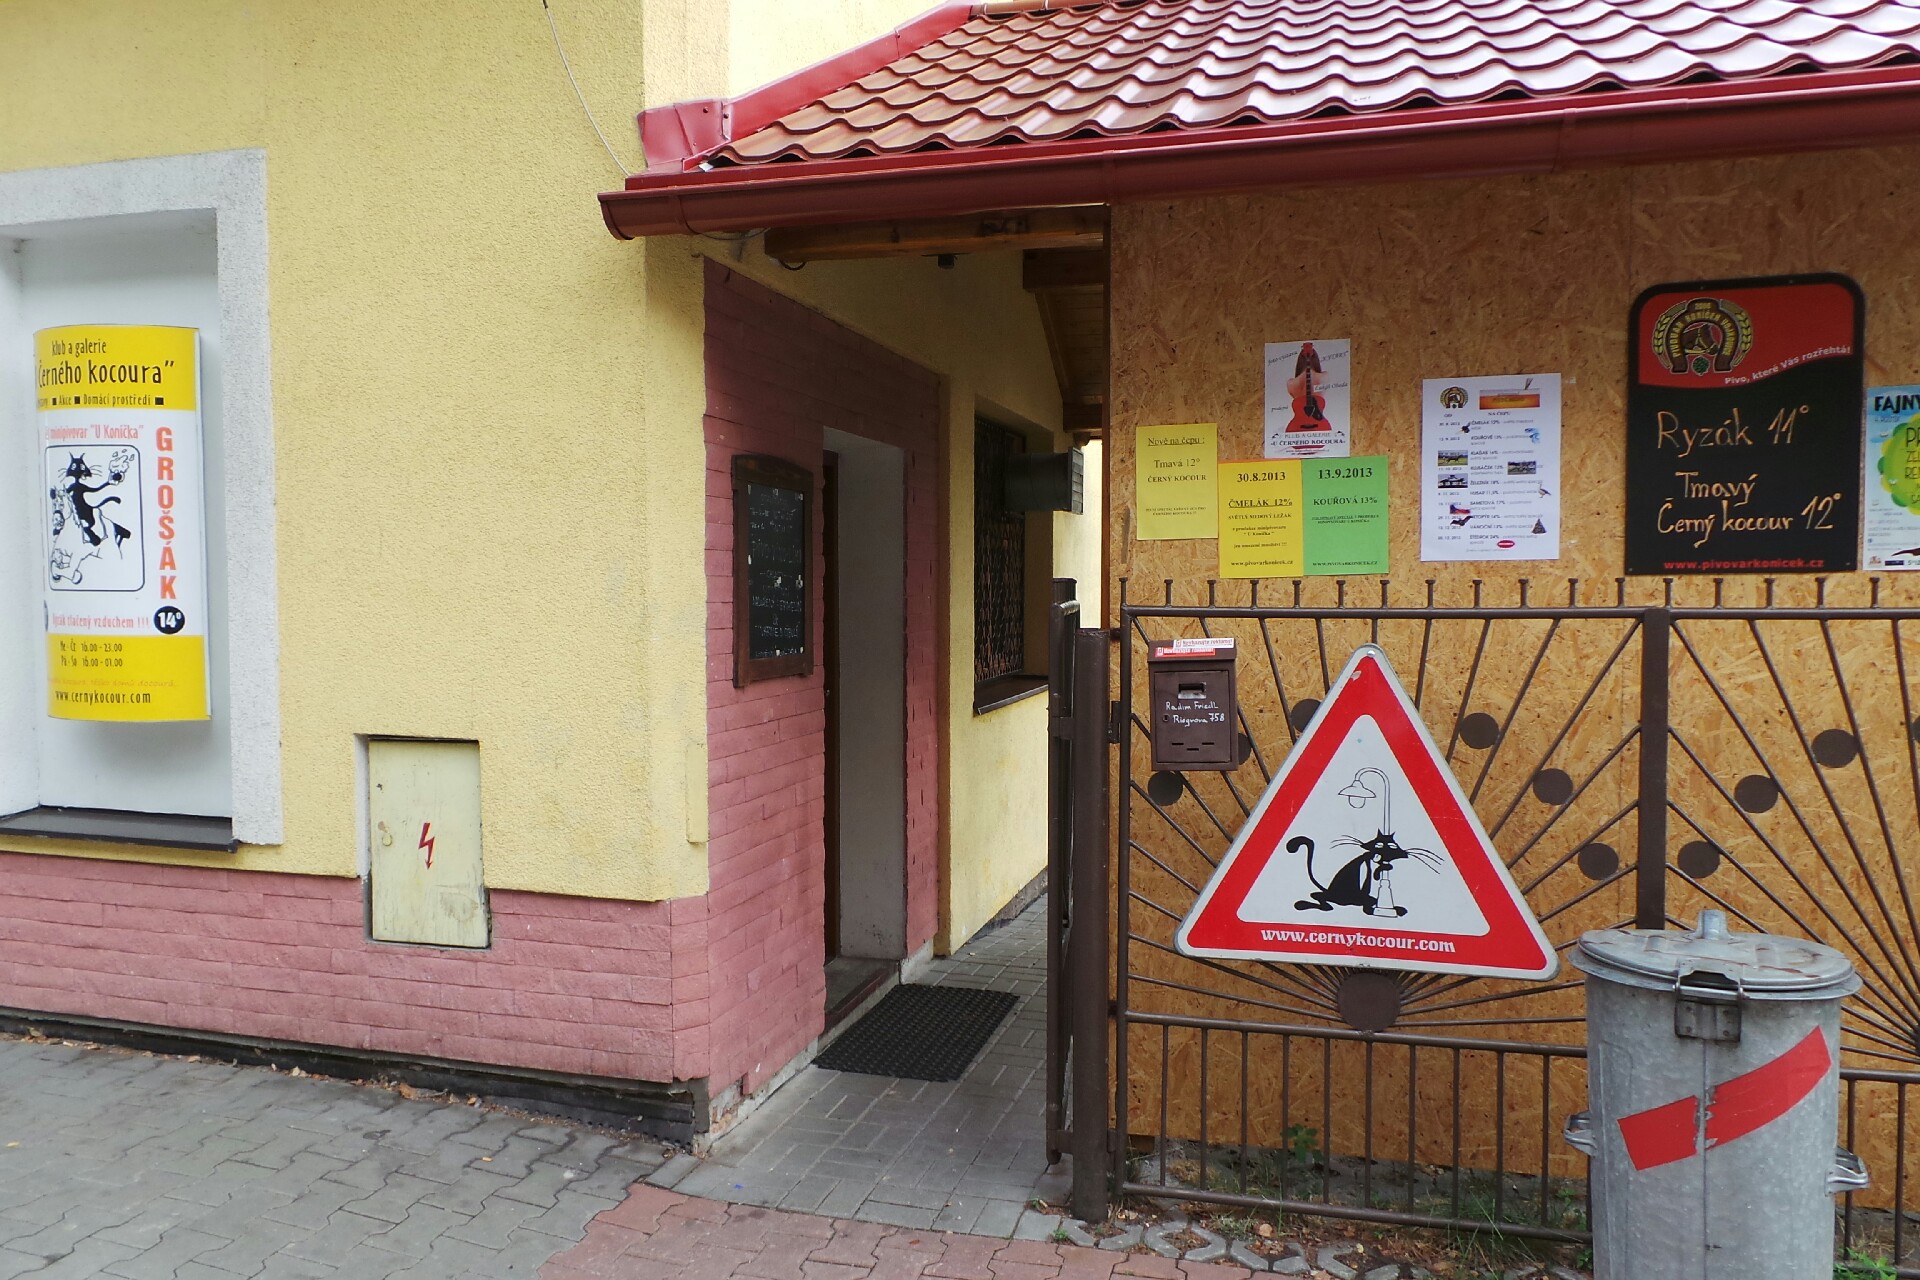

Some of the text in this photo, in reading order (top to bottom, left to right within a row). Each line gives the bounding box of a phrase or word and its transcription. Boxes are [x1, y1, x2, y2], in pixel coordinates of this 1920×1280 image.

[52, 339, 107, 358] klub a galerie
[1725, 345, 1851, 385] Pivo, které Vás rozřehtá!
[1657, 407, 1753, 458] Ryzák
[1181, 437, 1200, 447] čepu
[1154, 459, 1183, 468] Tmavá
[1147, 474, 1207, 483] ČERNÝ KOCOUR
[1237, 471, 1286, 483] 30.8.2013
[1318, 467, 1373, 479] 13.9.2013
[1675, 471, 1758, 507] Tmavý
[1228, 498, 1293, 508] ČMELÁK 12%
[1313, 495, 1359, 506] KOUŘOVÁ
[156, 426, 177, 600] GROŠÁK
[1657, 497, 1716, 549] Černý
[1722, 500, 1794, 531] kocour
[1664, 558, 1825, 569] www.pivovarkonicek.cz
[94, 616, 135, 629] vzduchem
[55, 690, 152, 706] www.cernykocour.com
[1166, 701, 1192, 711] Radim
[1208, 713, 1225, 722] 758
[1260, 929, 1456, 953] www.cernykocour.com
